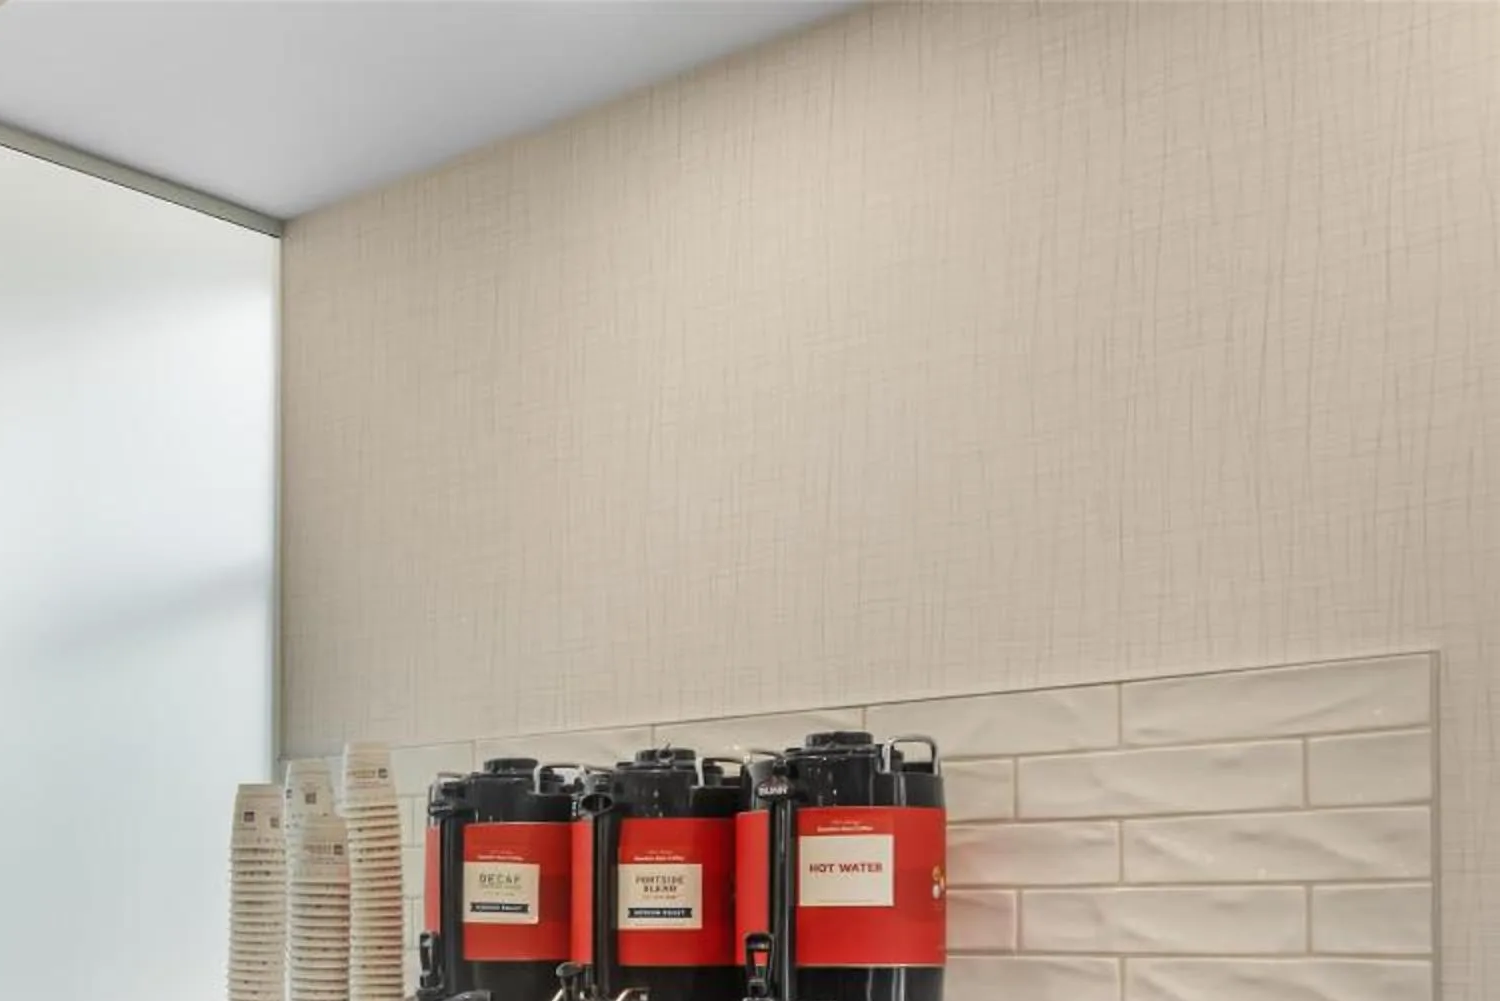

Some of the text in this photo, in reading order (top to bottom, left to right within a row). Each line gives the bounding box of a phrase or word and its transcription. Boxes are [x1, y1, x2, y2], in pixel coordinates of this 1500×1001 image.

[809, 863, 883, 873] HOT WATER
[479, 873, 521, 884] DECAF
